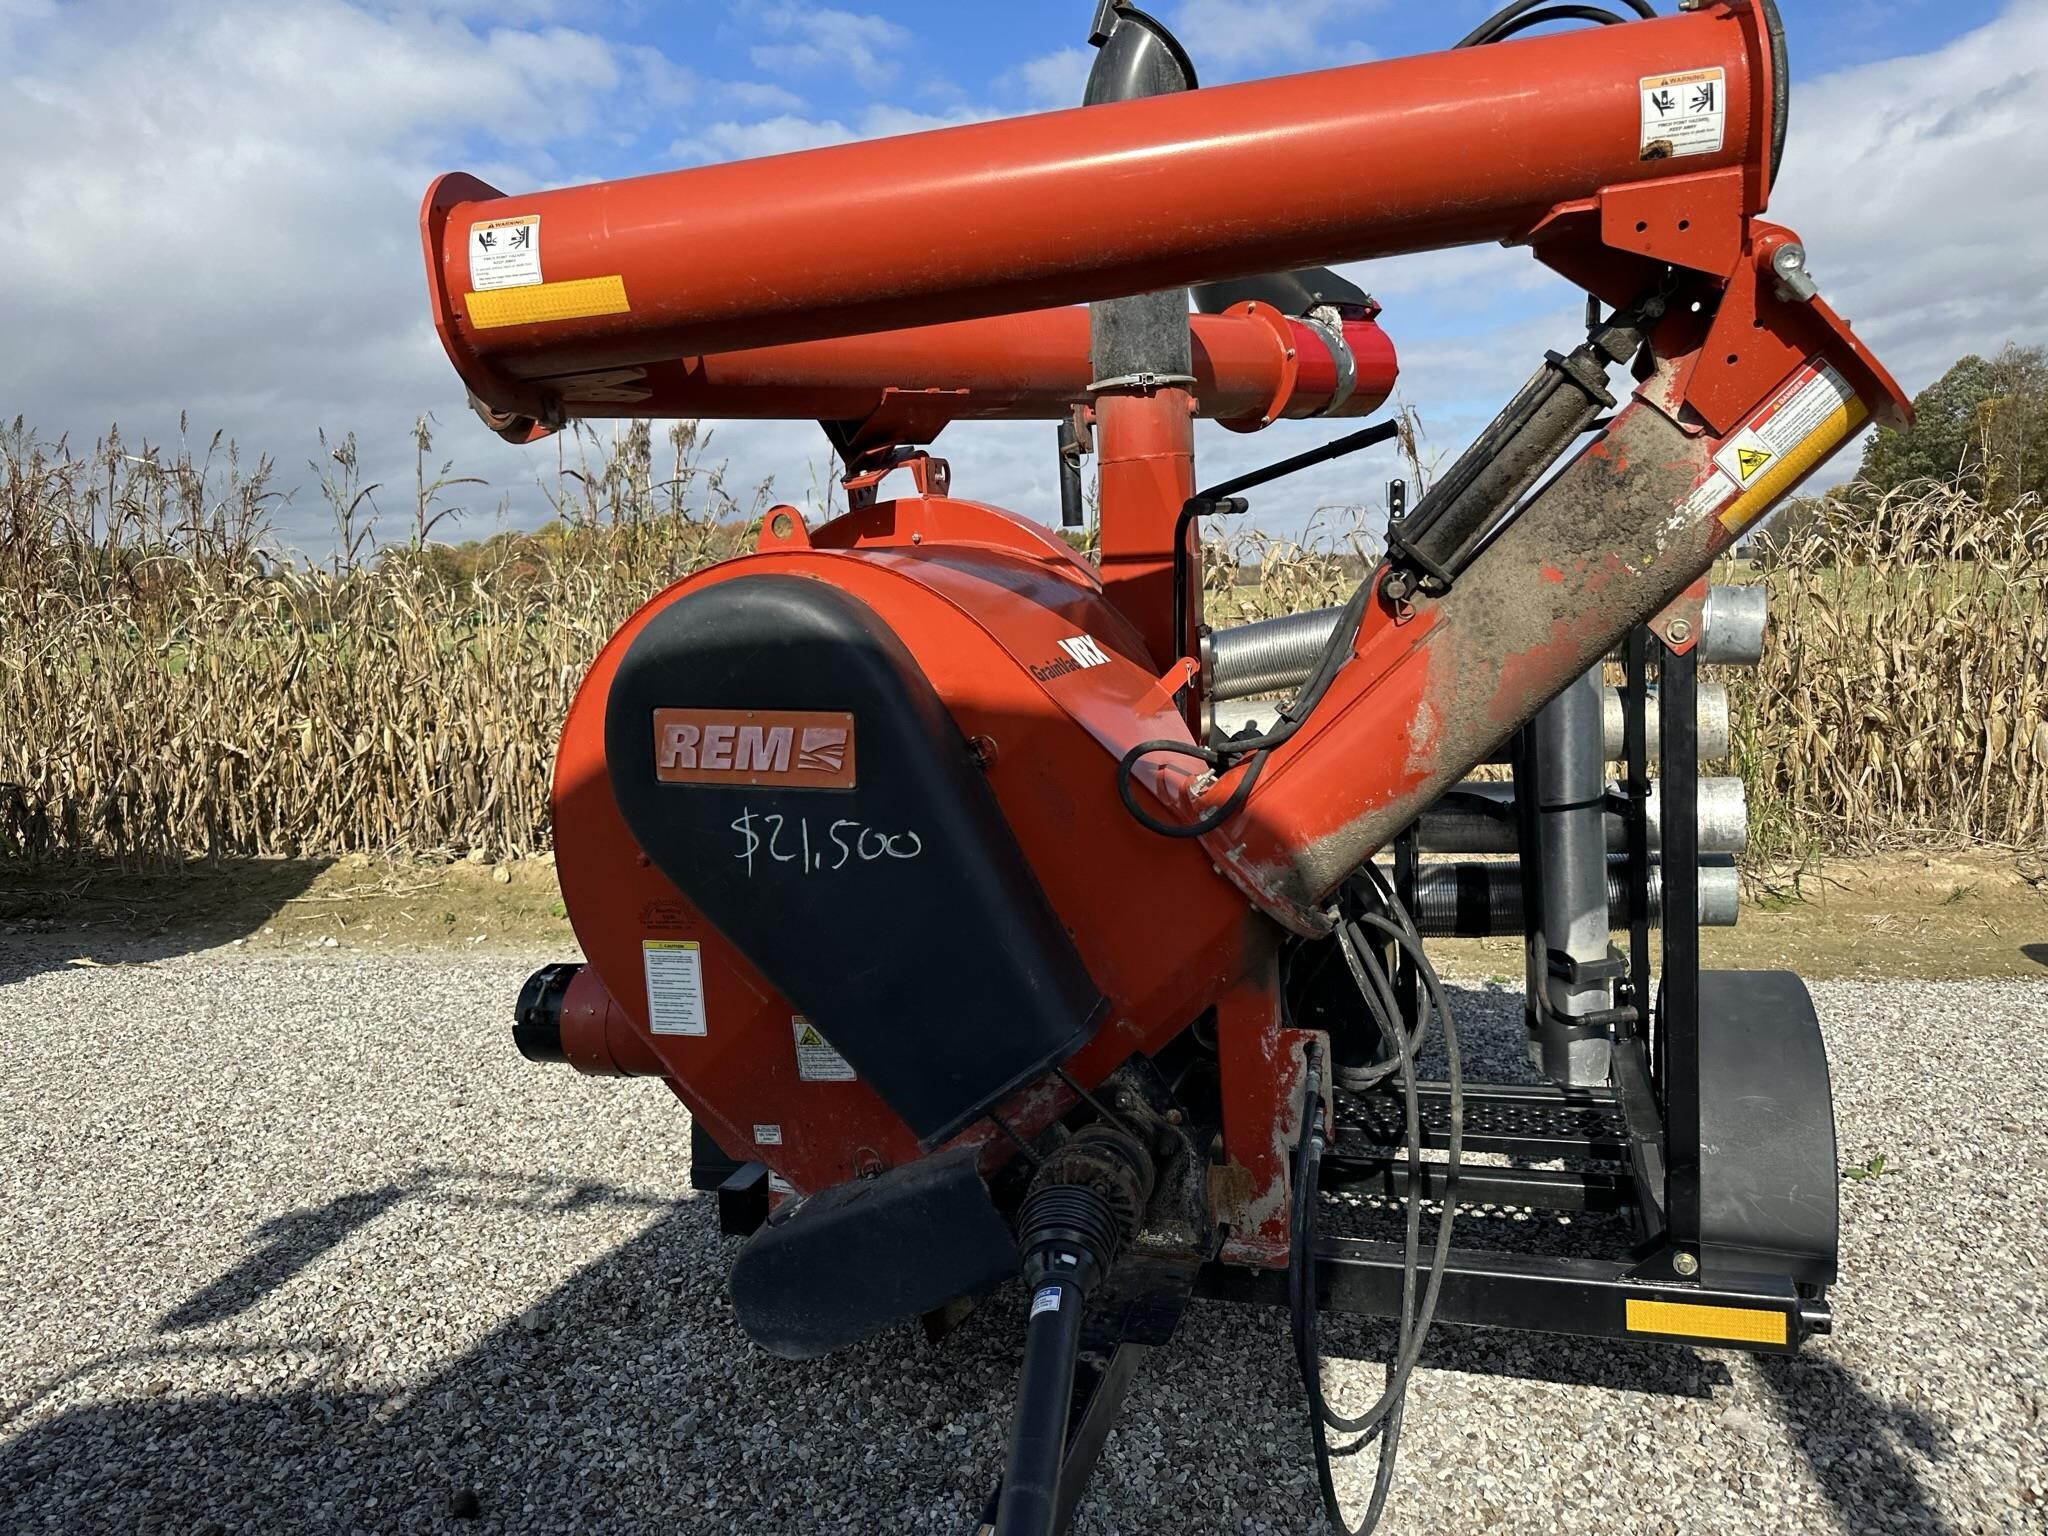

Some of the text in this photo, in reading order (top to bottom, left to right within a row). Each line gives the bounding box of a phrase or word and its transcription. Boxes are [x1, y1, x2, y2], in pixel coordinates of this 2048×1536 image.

[1670, 74, 1705, 84] WARNING
[495, 220, 525, 228] WARNING
[1778, 379, 1806, 404] DANGER
[1029, 634, 1112, 682] GrainVac VRX
[660, 723, 794, 773] REM
[730, 806, 922, 878] $21,500
